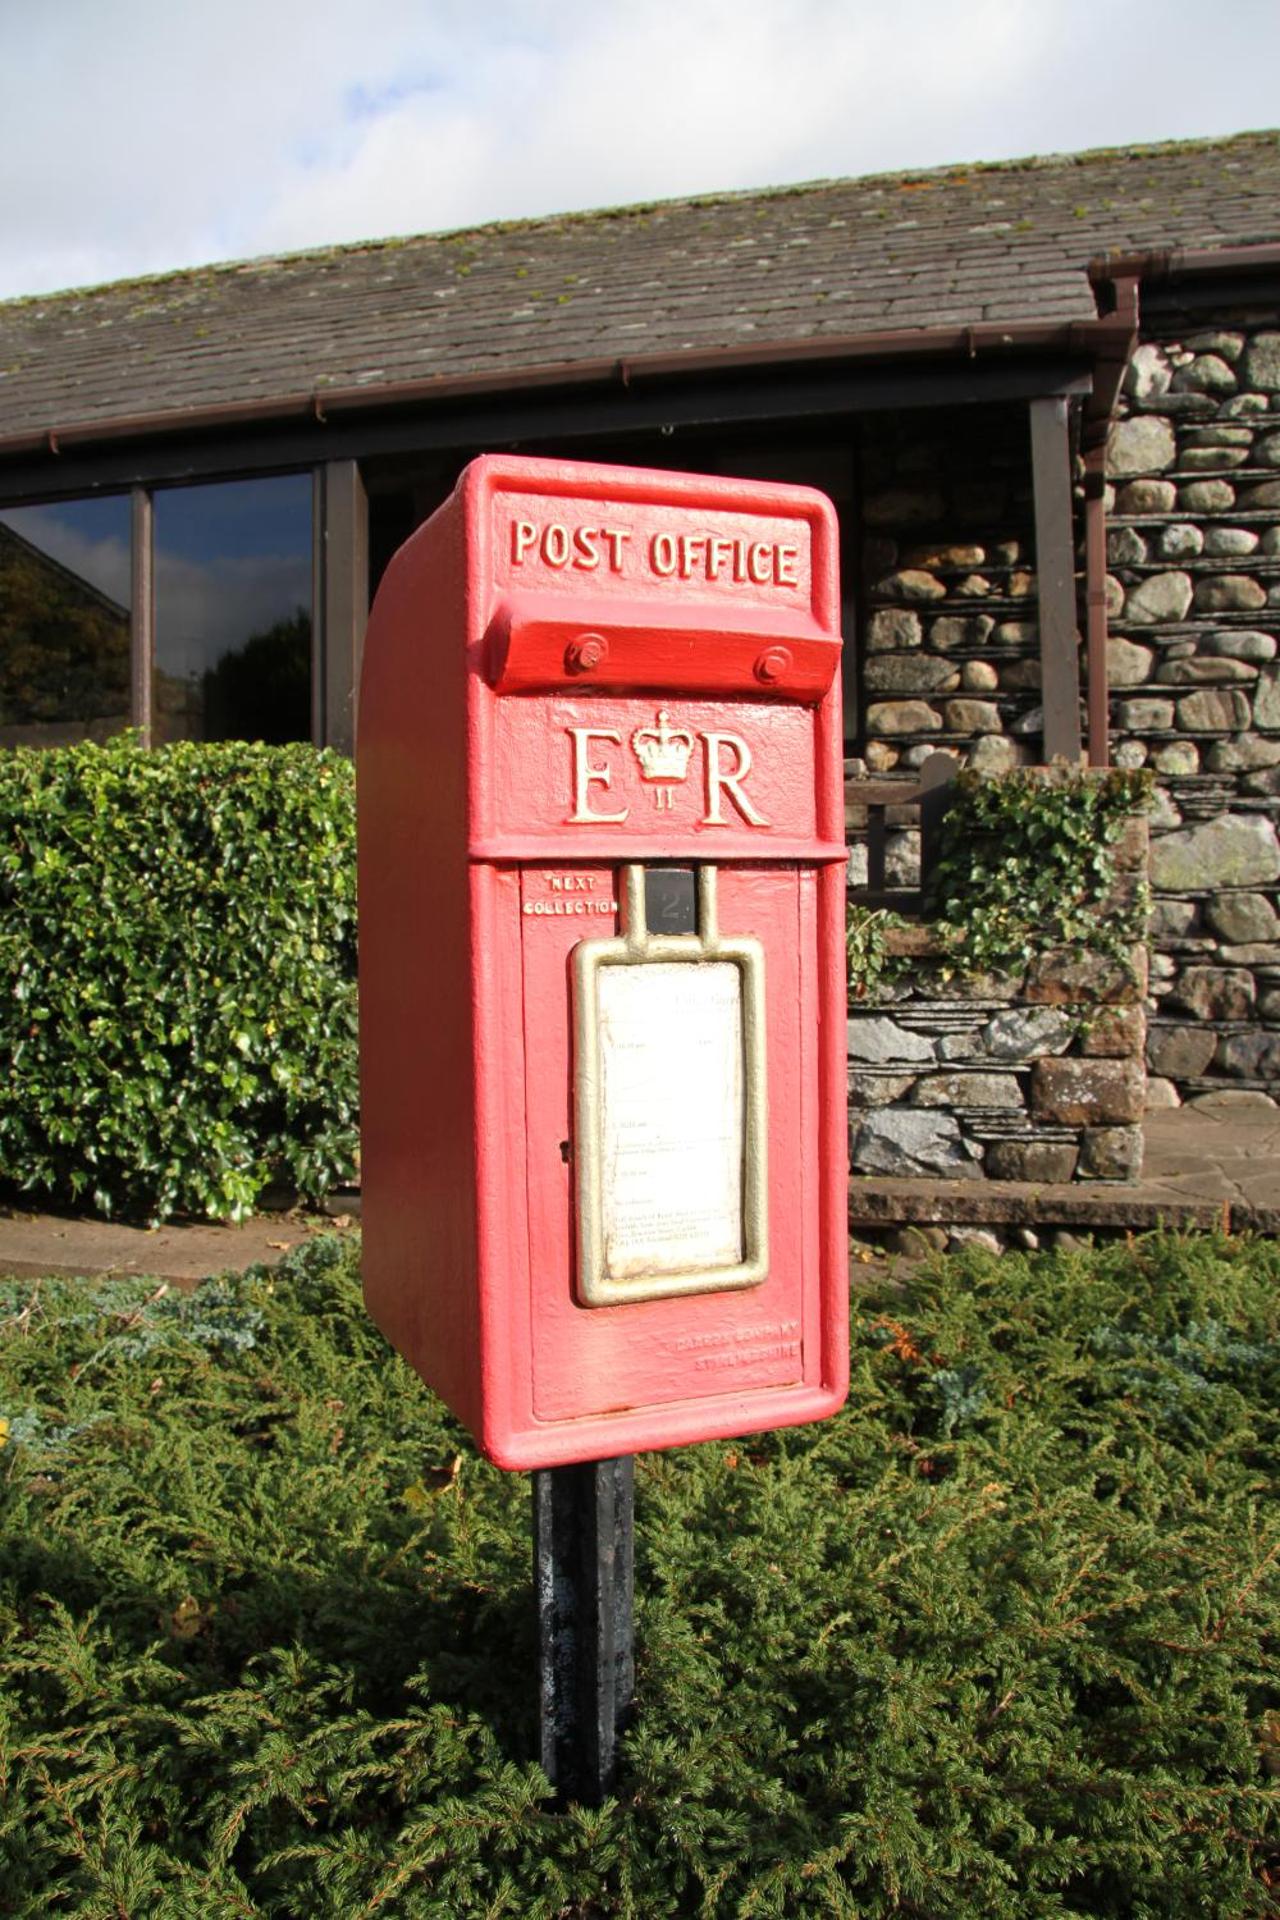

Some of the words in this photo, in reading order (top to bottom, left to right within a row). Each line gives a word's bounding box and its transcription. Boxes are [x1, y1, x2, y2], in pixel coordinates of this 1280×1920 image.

[512, 519, 632, 571] POST
[651, 533, 798, 587] OFFICE
[565, 727, 629, 825] E
[698, 730, 770, 827] R
[551, 876, 595, 891] NEXT
[523, 901, 618, 915] COLLECTION
